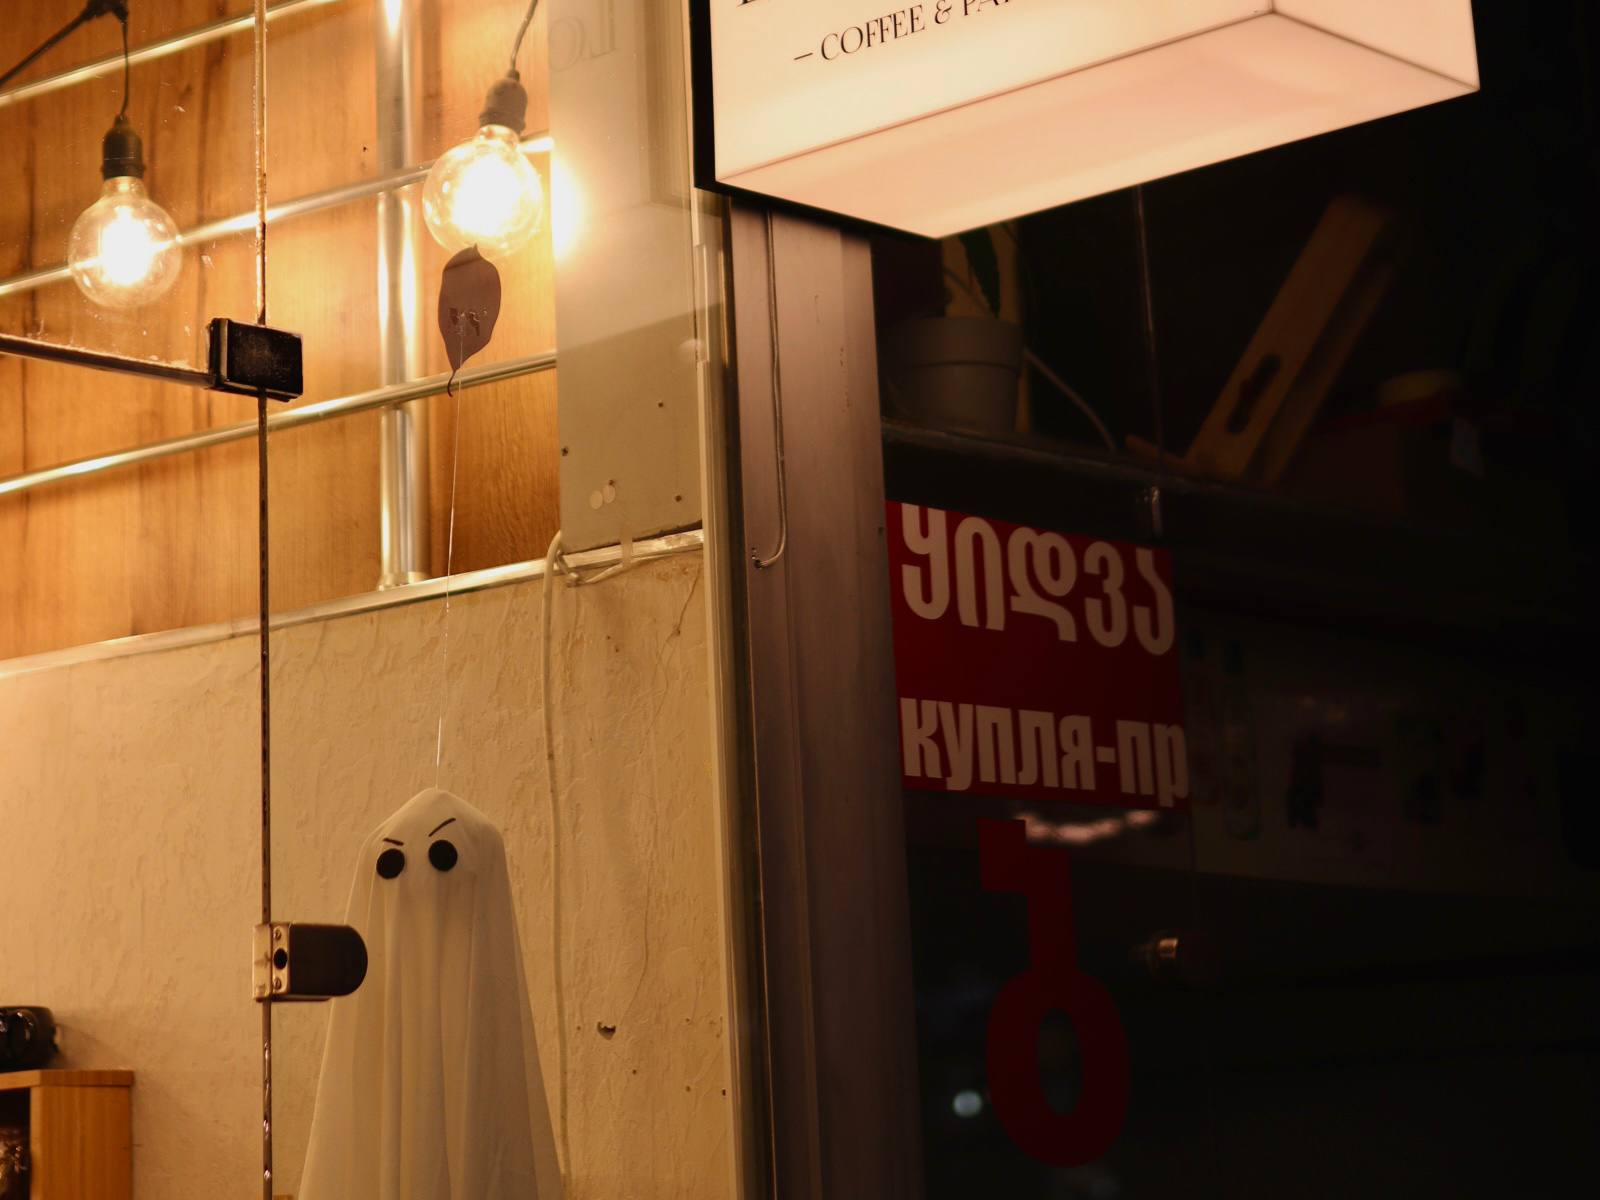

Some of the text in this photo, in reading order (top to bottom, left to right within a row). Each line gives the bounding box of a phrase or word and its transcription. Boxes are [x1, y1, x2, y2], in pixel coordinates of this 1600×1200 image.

[820, 4, 925, 61] COFFEE
[934, 0, 952, 25] &
[900, 502, 1175, 656] ყიდვა
[899, 696, 1190, 808] купля-пр
